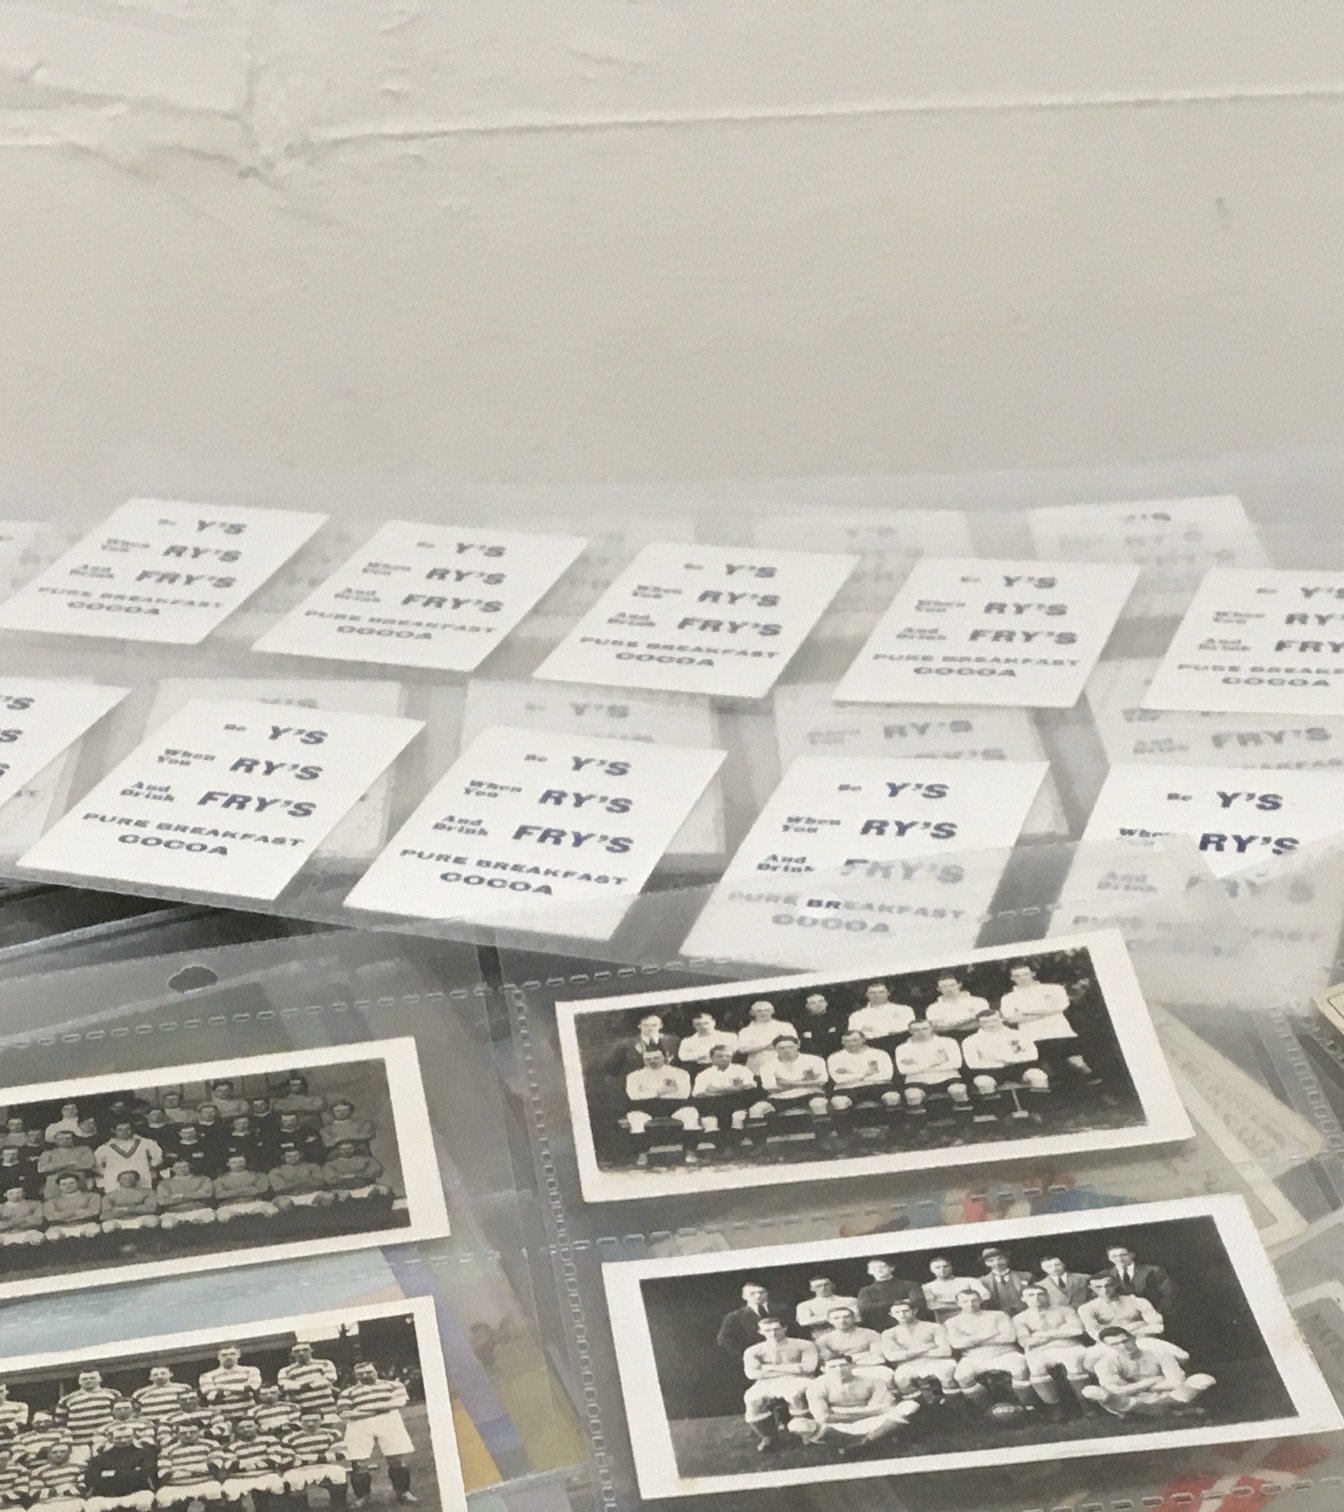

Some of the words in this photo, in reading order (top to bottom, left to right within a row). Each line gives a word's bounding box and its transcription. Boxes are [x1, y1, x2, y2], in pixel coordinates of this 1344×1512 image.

[196, 519, 247, 535] Y'S
[162, 545, 242, 562] RY'S
[456, 542, 506, 557] Y'S
[135, 570, 236, 588] FRY'S
[425, 567, 506, 585] RY'S
[725, 563, 777, 578] Y'S
[1003, 576, 1055, 588] Y'S
[401, 594, 504, 612] FRY'S
[697, 590, 780, 607] RY'S
[67, 602, 160, 615] COCOA
[983, 602, 1068, 615] RY'S
[337, 626, 432, 639] COCOA
[677, 617, 782, 636] FRY'S
[968, 629, 1077, 644] FRY'S
[616, 652, 714, 667] COCOA
[913, 667, 1017, 677] COCOA
[1222, 677, 1330, 686] COCOA
[268, 725, 328, 745] Y'S
[229, 757, 323, 781] RY'S
[571, 756, 631, 776] Y'S
[886, 782, 949, 799] Y'S
[197, 790, 317, 817] FRY'S
[538, 789, 633, 813] RY'S
[1216, 791, 1284, 811] Y'S
[82, 813, 150, 828] PURE
[156, 822, 306, 846] BREAKFAST
[860, 819, 958, 839] RY'S
[118, 834, 228, 856] COCOA
[512, 824, 634, 853] FRY'S
[1199, 833, 1300, 855] RY'S
[399, 849, 468, 865] PURE
[476, 860, 628, 885] BREAKFAST
[440, 872, 553, 895] COCOA
